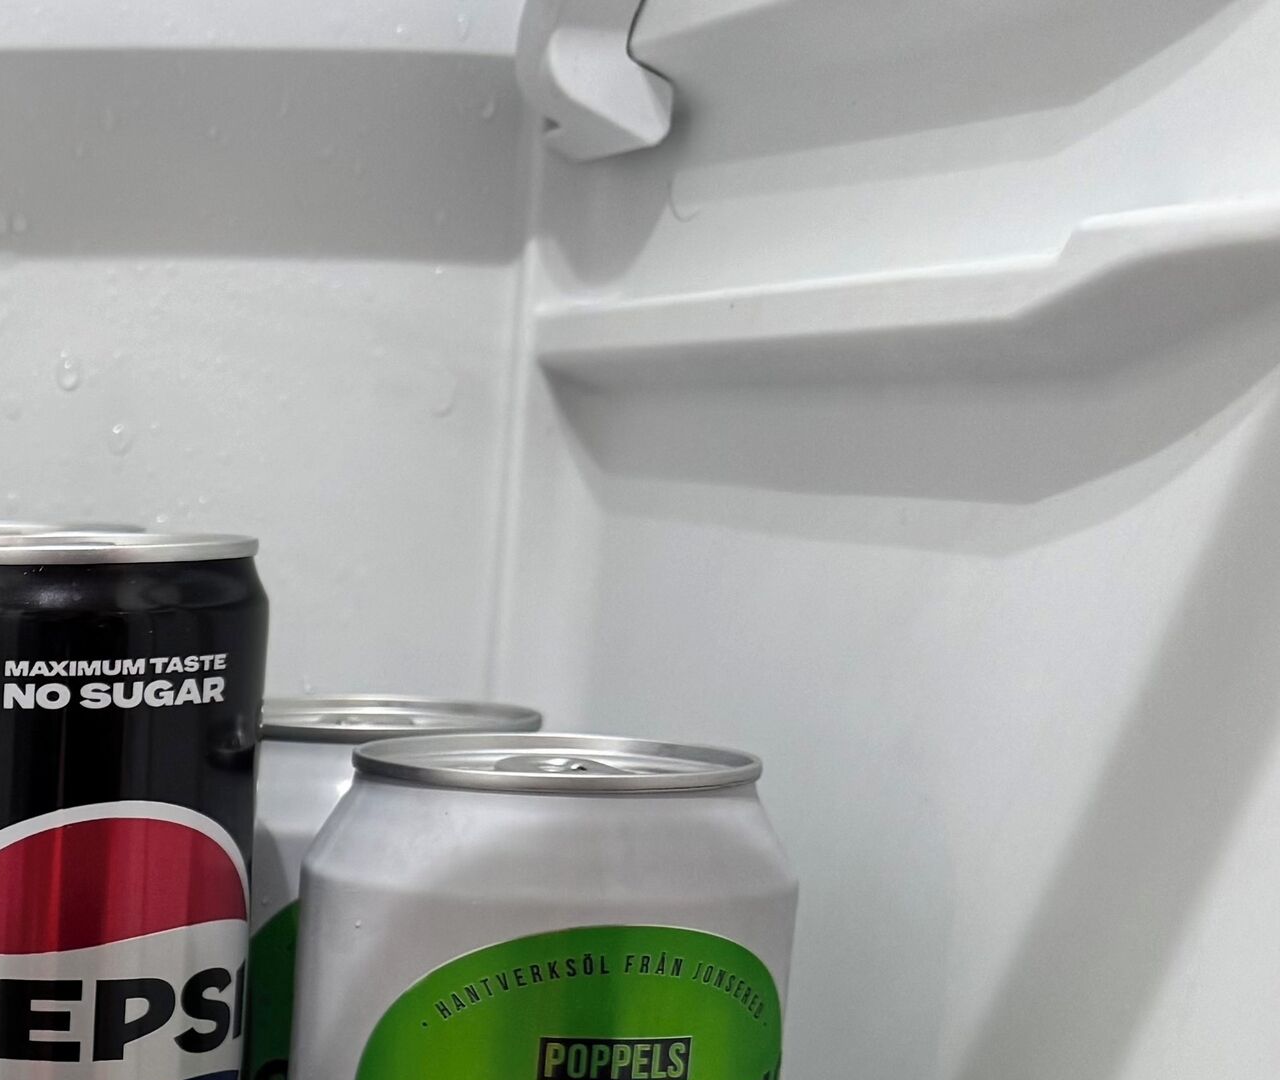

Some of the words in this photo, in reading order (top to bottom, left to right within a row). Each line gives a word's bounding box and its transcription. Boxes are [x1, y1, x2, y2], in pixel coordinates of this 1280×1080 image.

[4, 658, 146, 677] MAXIMUM
[150, 653, 227, 674] TASTE
[3, 682, 71, 710] NO
[80, 676, 226, 710] SUGAR
[434, 953, 610, 1019] HANTVERKSÖL
[624, 951, 683, 977] FRÅN
[692, 962, 764, 1019] JONSERED
[542, 1041, 688, 1080] POPPELS
